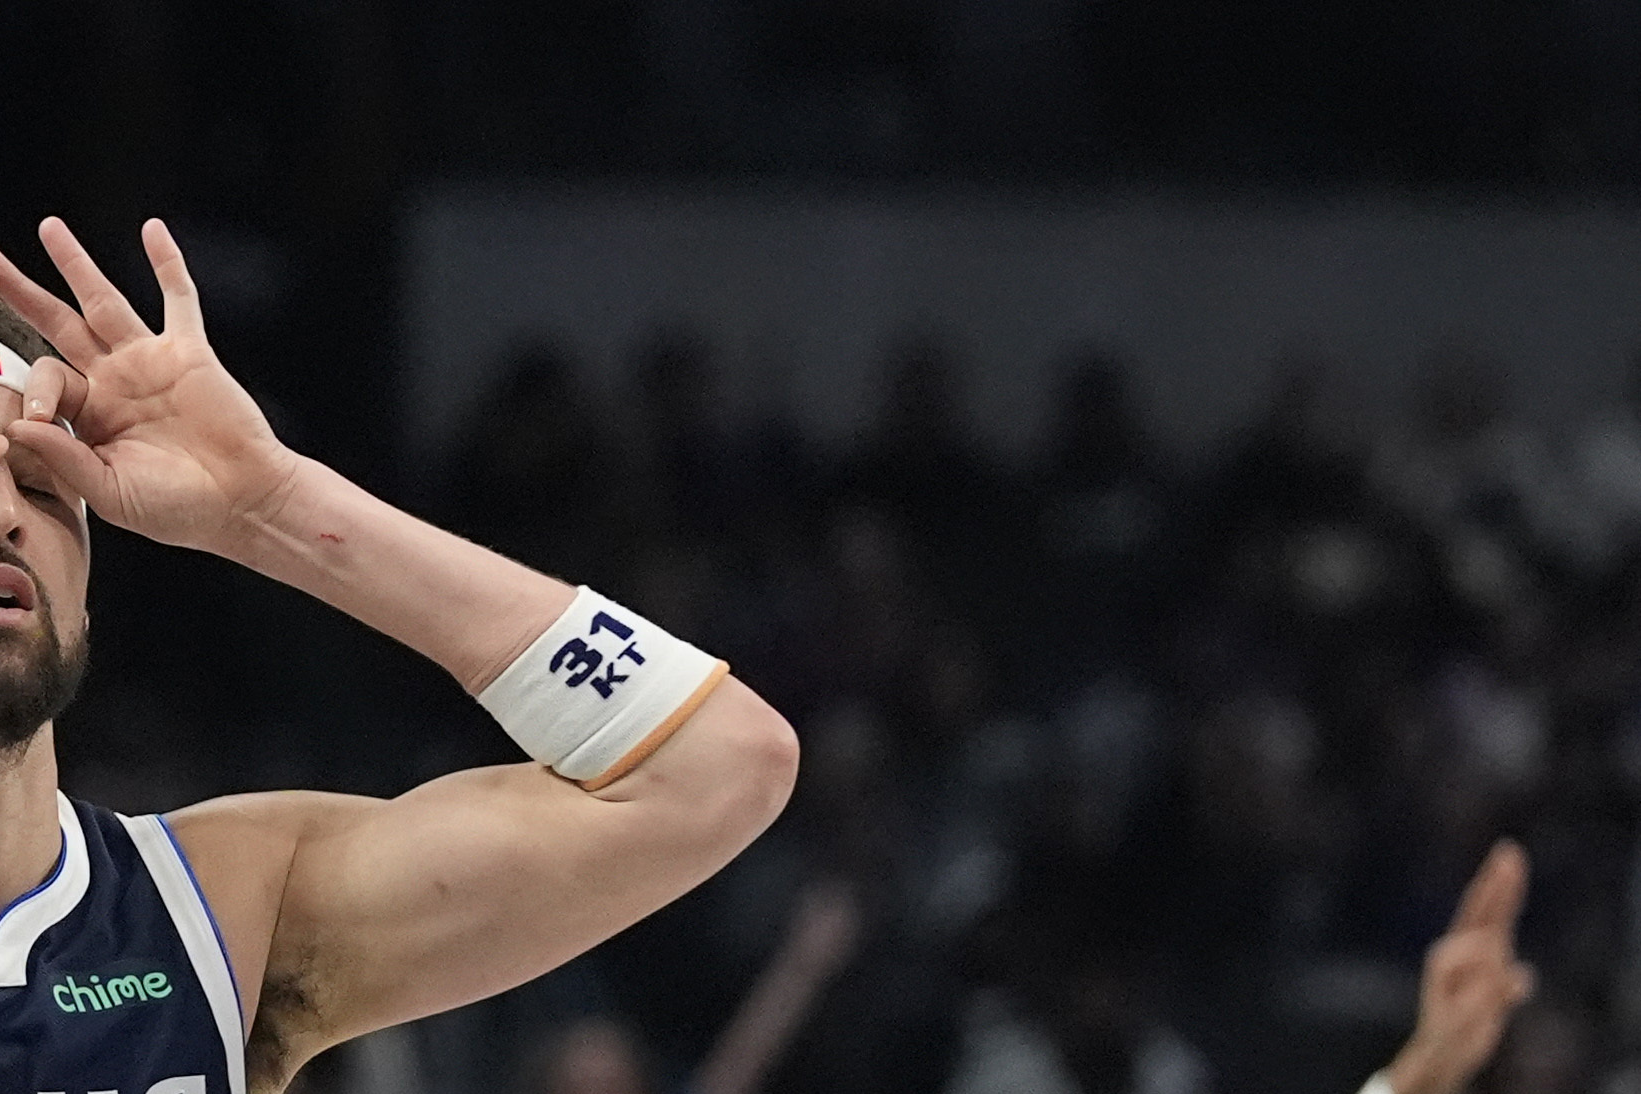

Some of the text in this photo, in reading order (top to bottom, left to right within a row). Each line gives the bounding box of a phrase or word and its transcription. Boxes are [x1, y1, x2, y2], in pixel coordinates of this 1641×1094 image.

[549, 610, 635, 688] 31
[589, 641, 646, 699] KT
[52, 971, 173, 1013] chime
